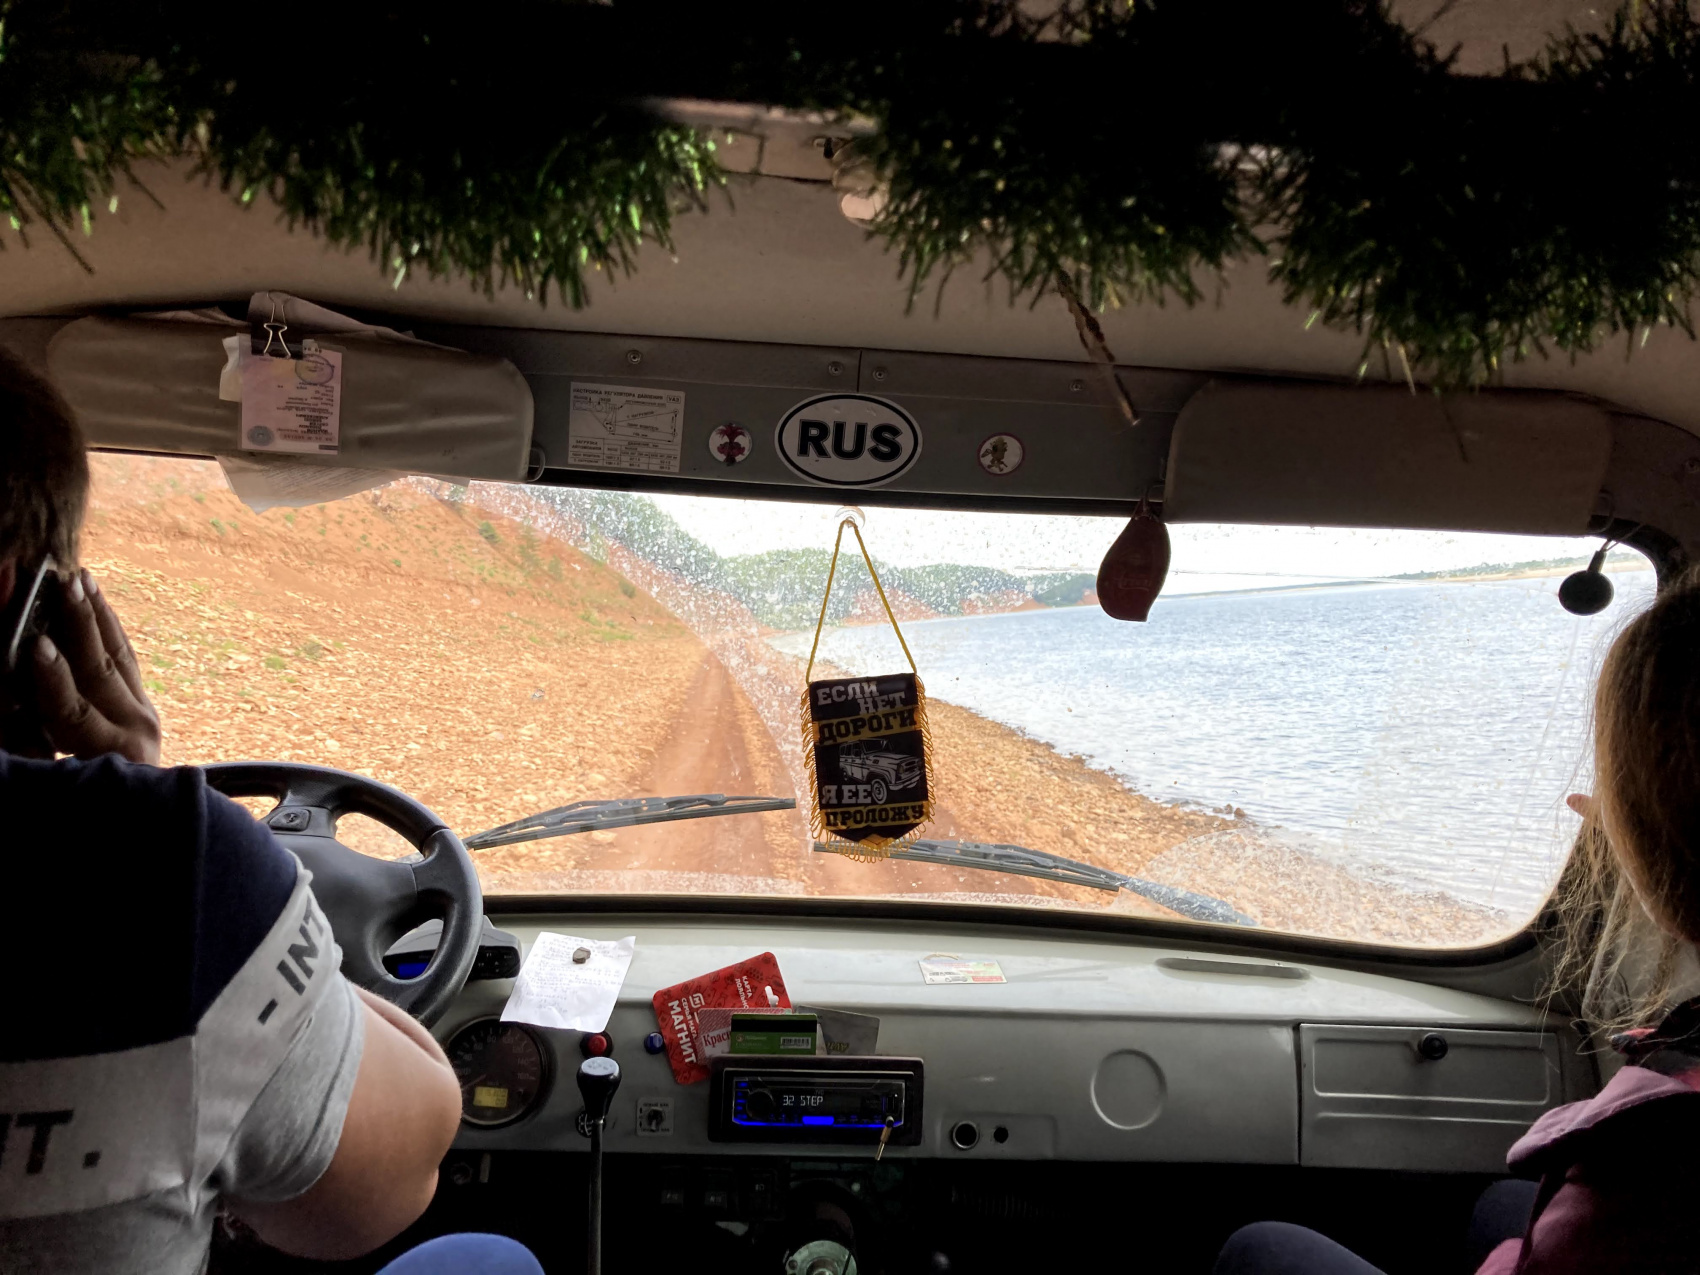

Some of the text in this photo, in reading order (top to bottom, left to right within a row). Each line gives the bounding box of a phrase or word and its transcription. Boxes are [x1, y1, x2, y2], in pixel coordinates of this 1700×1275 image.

[797, 418, 903, 463] RUS
[816, 680, 879, 706] ЕСЛИ
[857, 692, 906, 716] НЕТ
[818, 708, 917, 745] ДОРОГИ
[821, 784, 872, 805] Я ЕЕ
[824, 803, 925, 827] ПРОЛОЖУ
[741, 975, 753, 999] КАРТА
[681, 997, 692, 1022] СЕМЬЯ
[667, 1000, 697, 1064] МАГНИТ
[782, 1095, 824, 1107] 32 STEP
